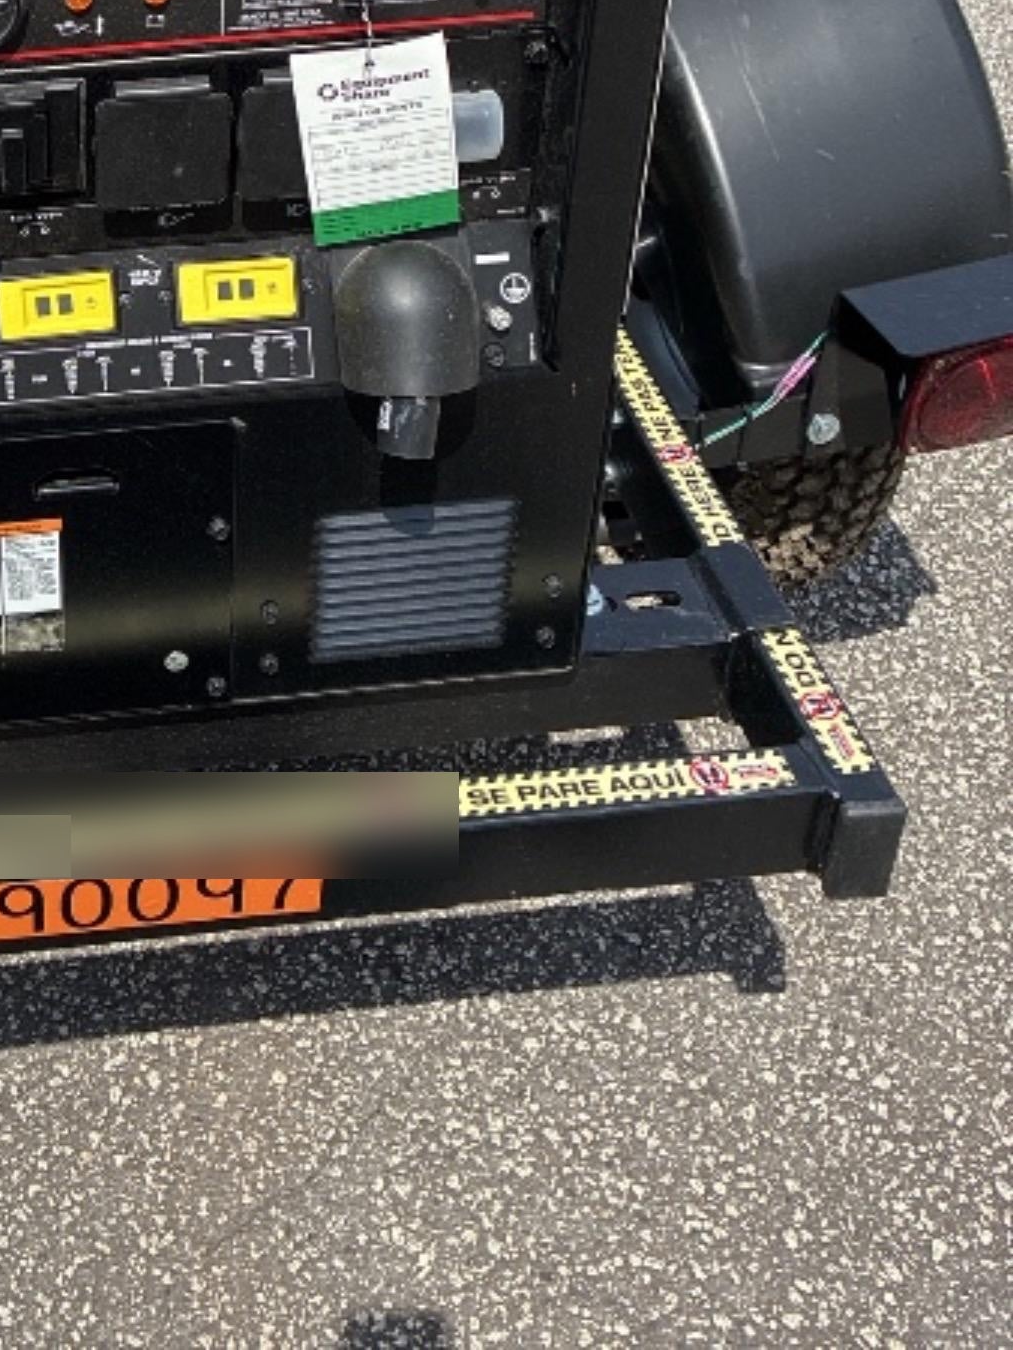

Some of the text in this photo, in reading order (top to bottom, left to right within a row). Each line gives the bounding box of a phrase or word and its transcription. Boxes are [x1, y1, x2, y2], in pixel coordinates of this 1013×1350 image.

[340, 68, 430, 91] Equipment
[340, 88, 391, 102] Share
[468, 786, 509, 806] SE
[516, 778, 602, 802] PARE
